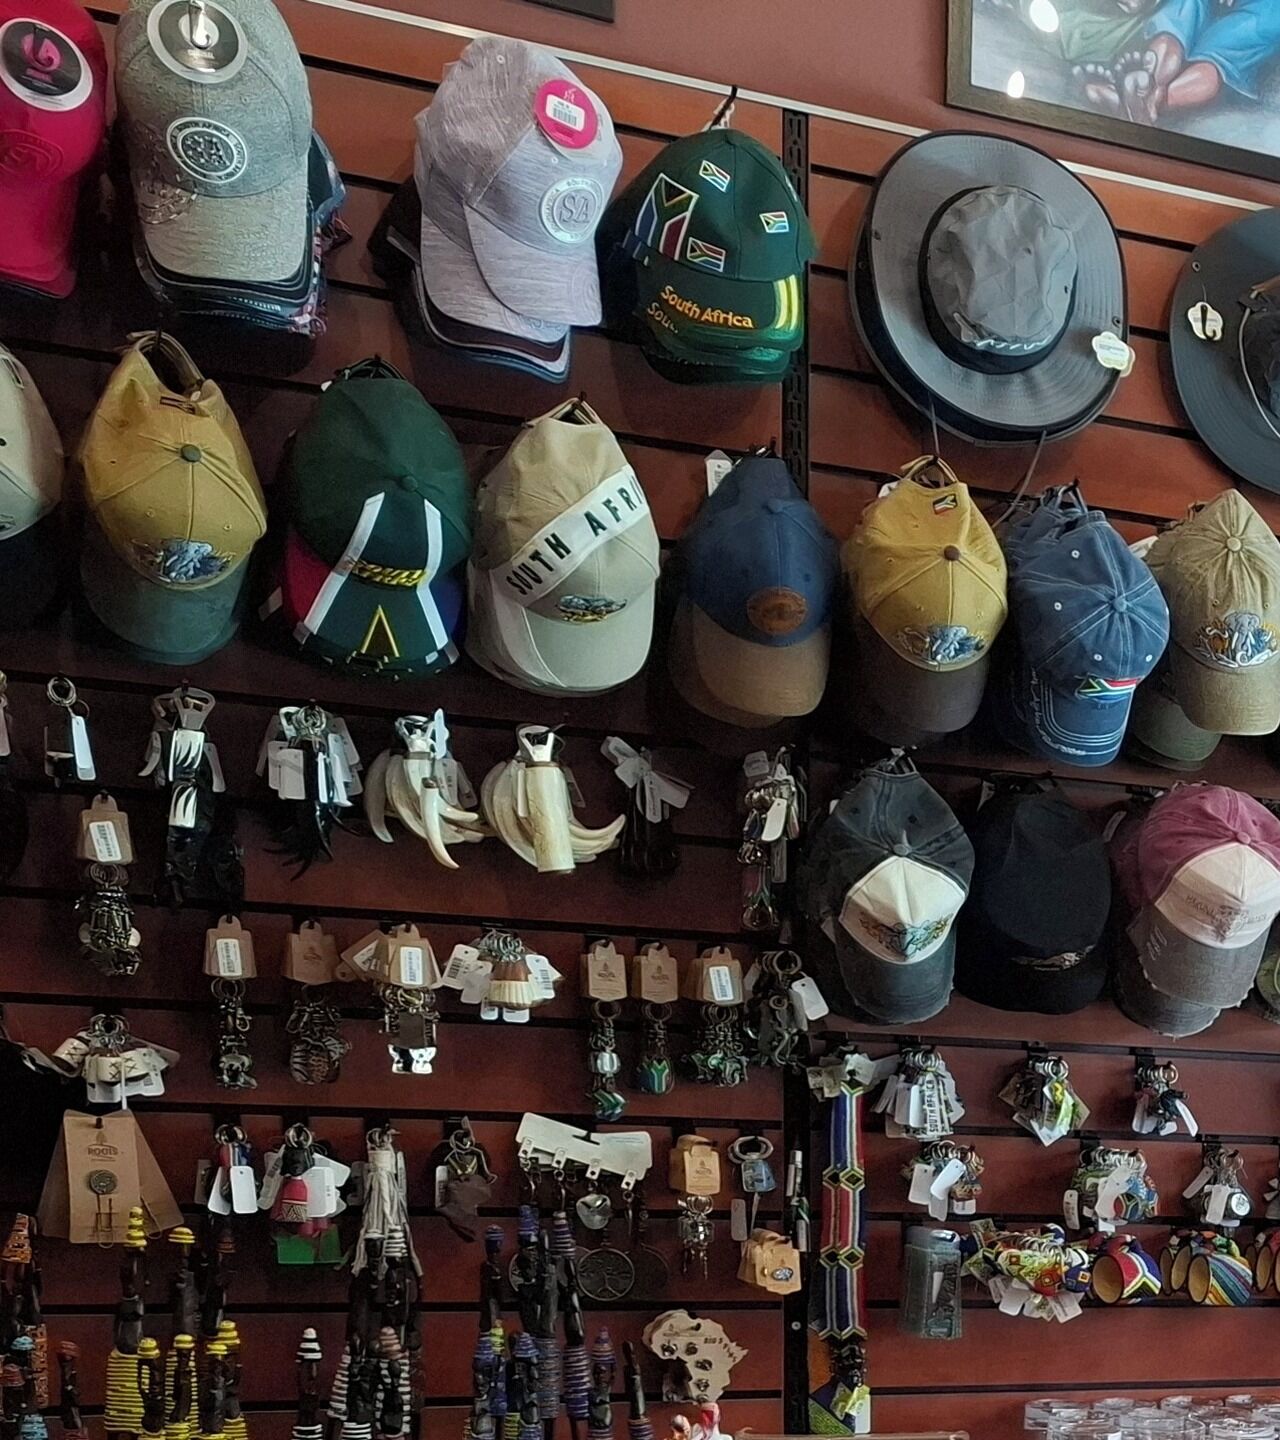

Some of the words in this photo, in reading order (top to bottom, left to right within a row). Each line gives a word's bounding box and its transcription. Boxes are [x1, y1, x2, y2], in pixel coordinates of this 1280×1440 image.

[647, 302, 679, 334] Sou
[660, 284, 701, 320] South
[701, 307, 755, 330] Africa
[506, 532, 572, 596] SOUTH
[584, 475, 645, 537] AFRI
